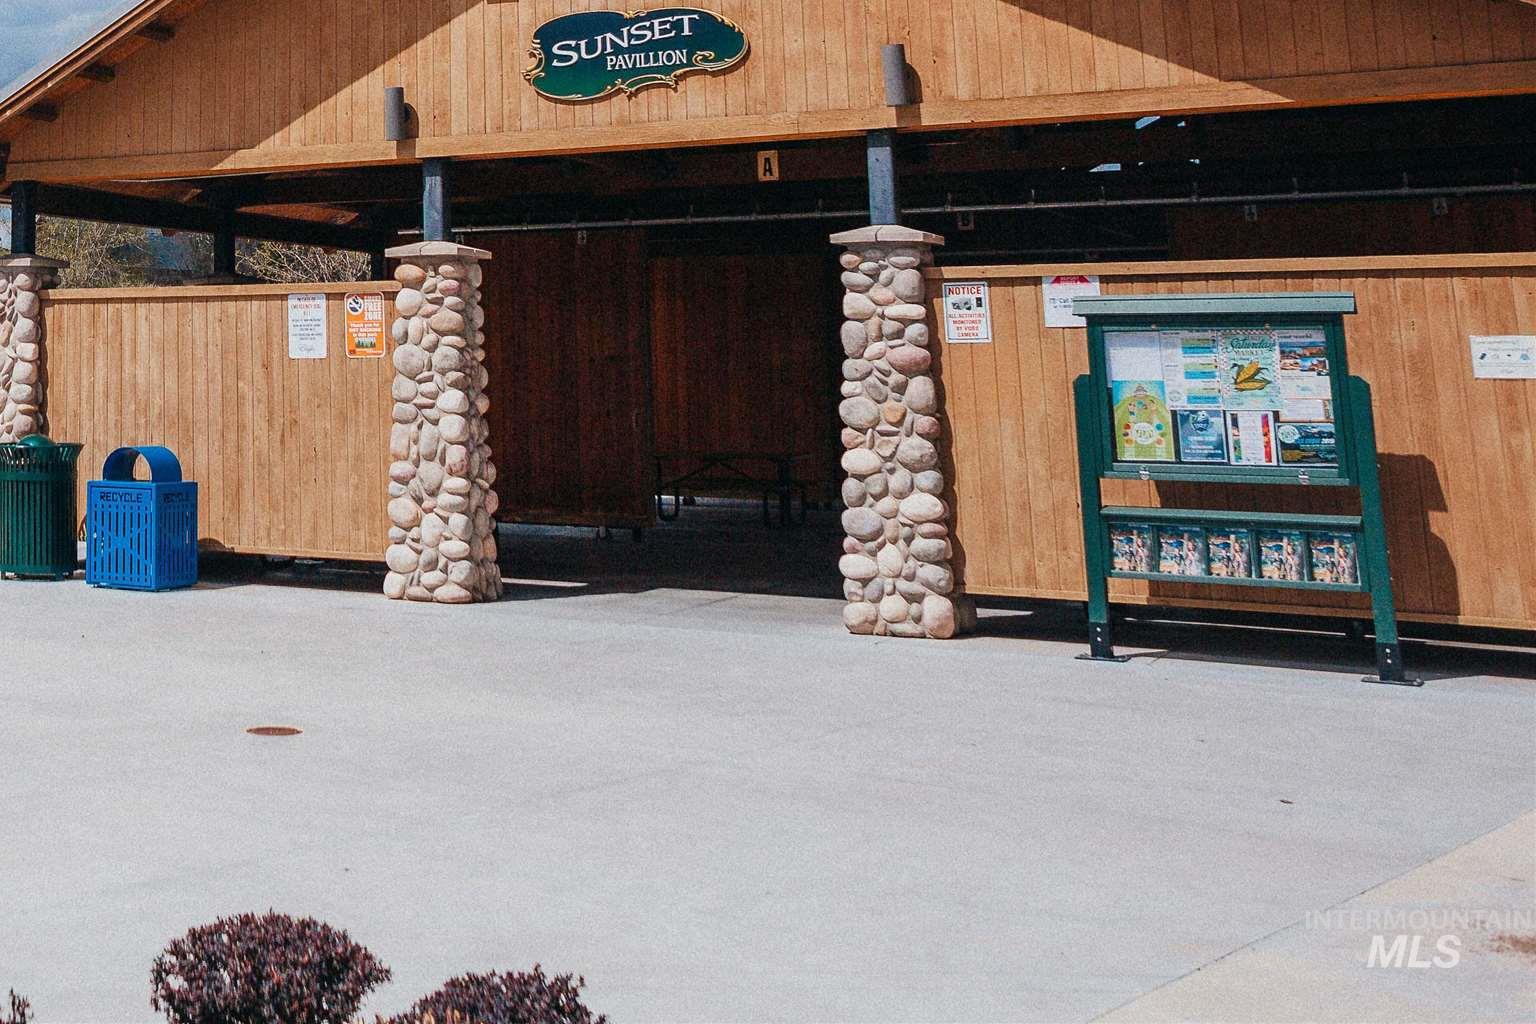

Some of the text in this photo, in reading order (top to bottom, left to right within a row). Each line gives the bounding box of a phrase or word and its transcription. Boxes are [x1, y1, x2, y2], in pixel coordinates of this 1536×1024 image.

[551, 15, 699, 67] SUNSET
[606, 49, 687, 71] PAVILLION
[763, 157, 774, 177] A
[948, 287, 982, 295] NOTICE
[1230, 337, 1275, 351] Saturday
[99, 491, 143, 503] RECYCLE
